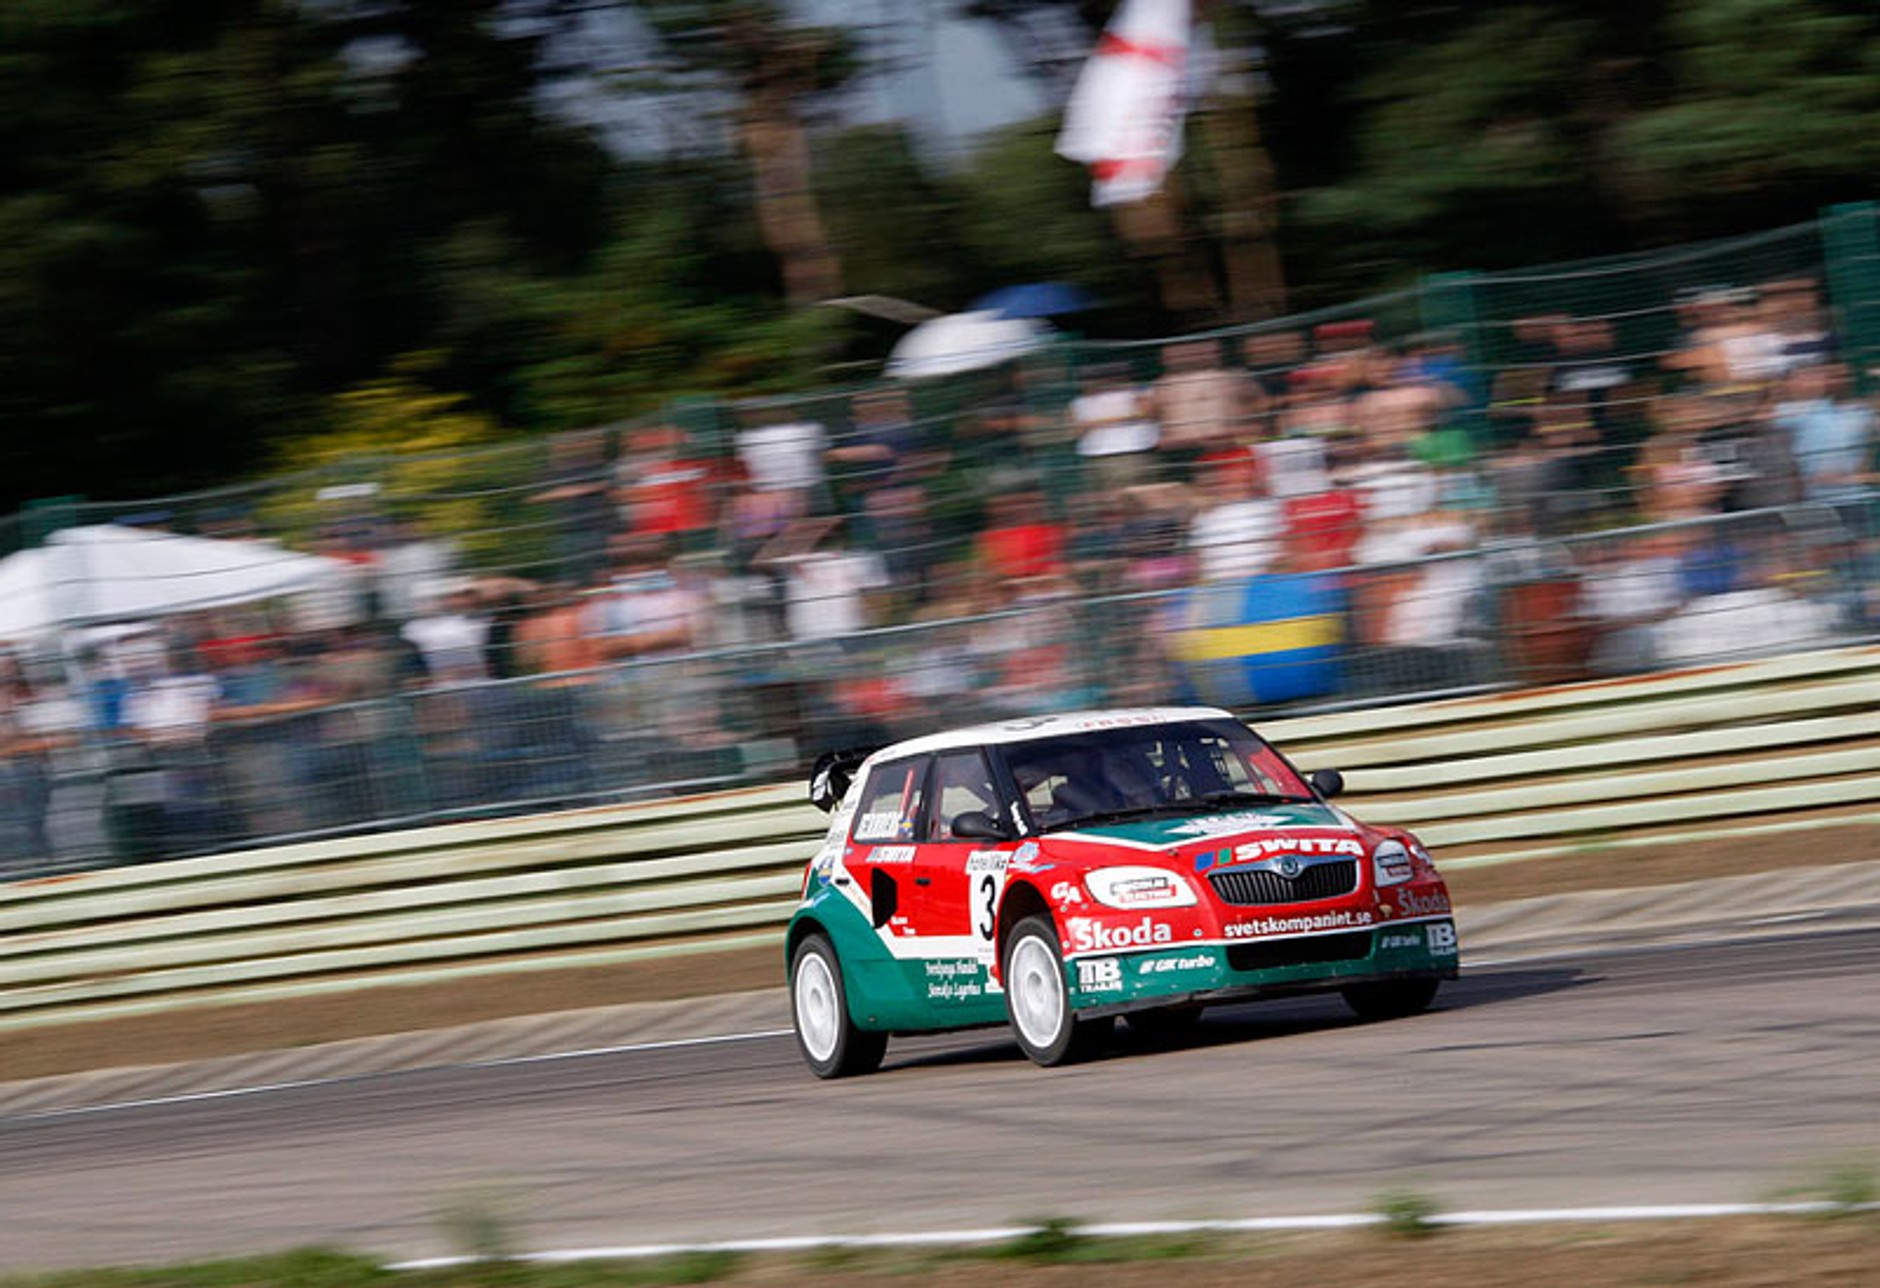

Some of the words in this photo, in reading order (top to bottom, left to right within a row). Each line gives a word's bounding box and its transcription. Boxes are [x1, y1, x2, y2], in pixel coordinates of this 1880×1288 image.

[1235, 838, 1365, 861] SWITA
[979, 874, 996, 941] 3
[1397, 887, 1450, 916] Škoda
[1073, 916, 1172, 950] Škoda
[1224, 911, 1372, 937] svetskompaniet.se
